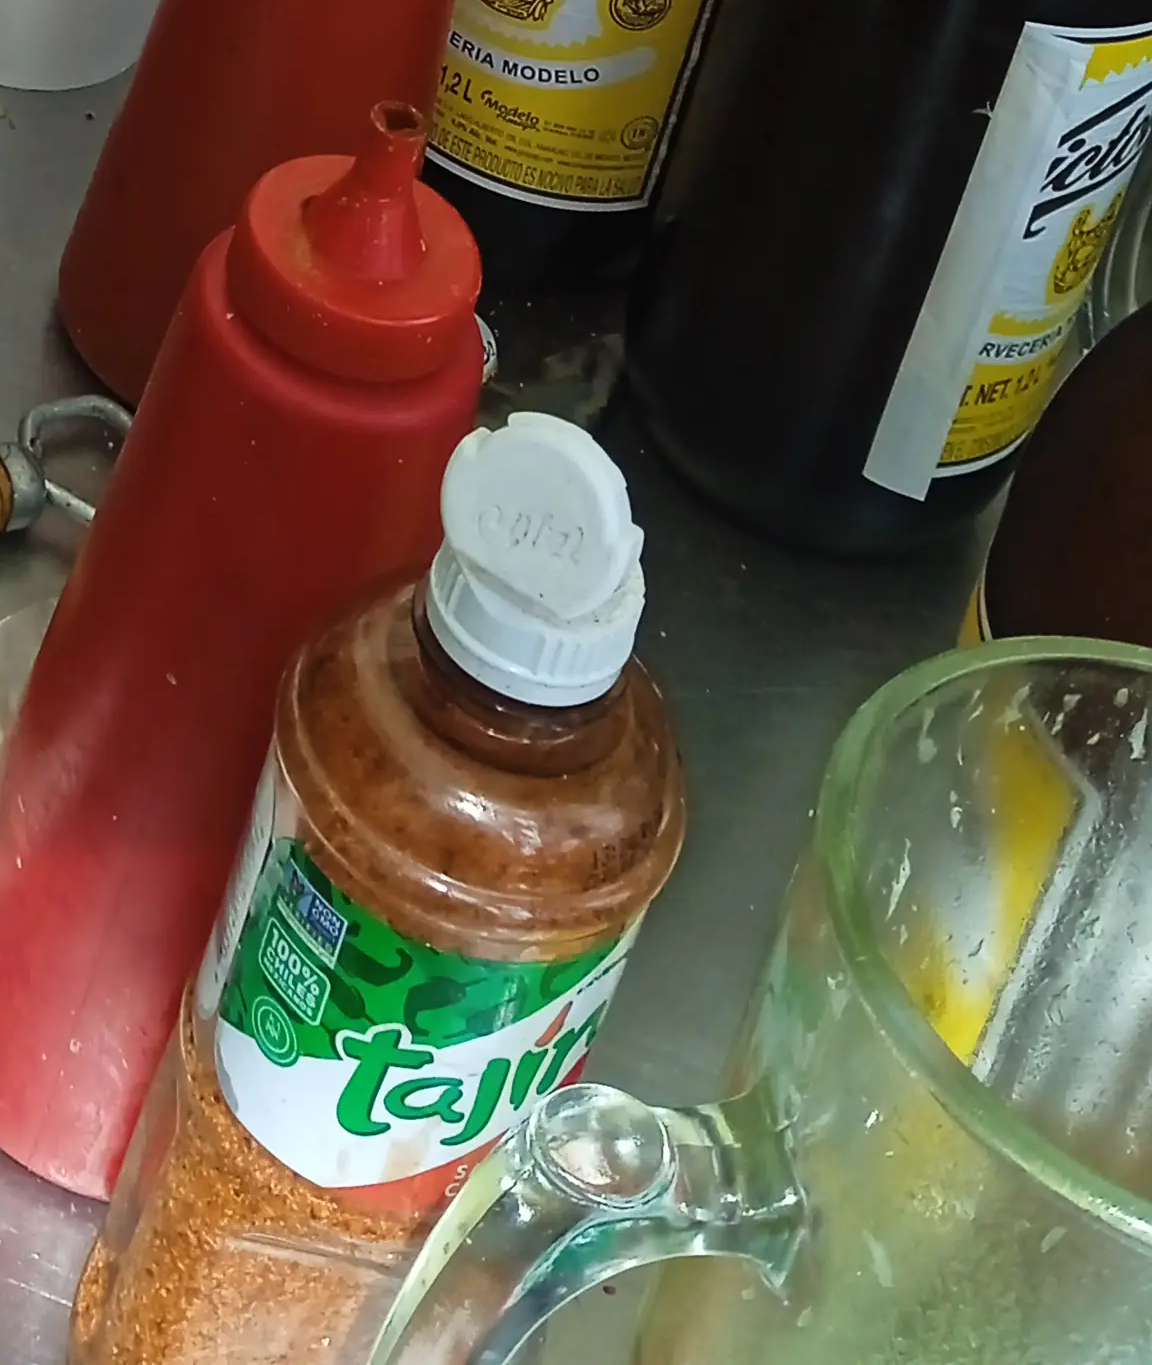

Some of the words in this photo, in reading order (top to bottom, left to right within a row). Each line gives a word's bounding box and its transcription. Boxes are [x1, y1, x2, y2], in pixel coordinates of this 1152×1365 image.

[501, 58, 600, 85] MODELO
[311, 907, 340, 939] GMO
[314, 897, 342, 931] NON
[264, 945, 318, 1011] CHILES
[270, 927, 321, 997] 100%
